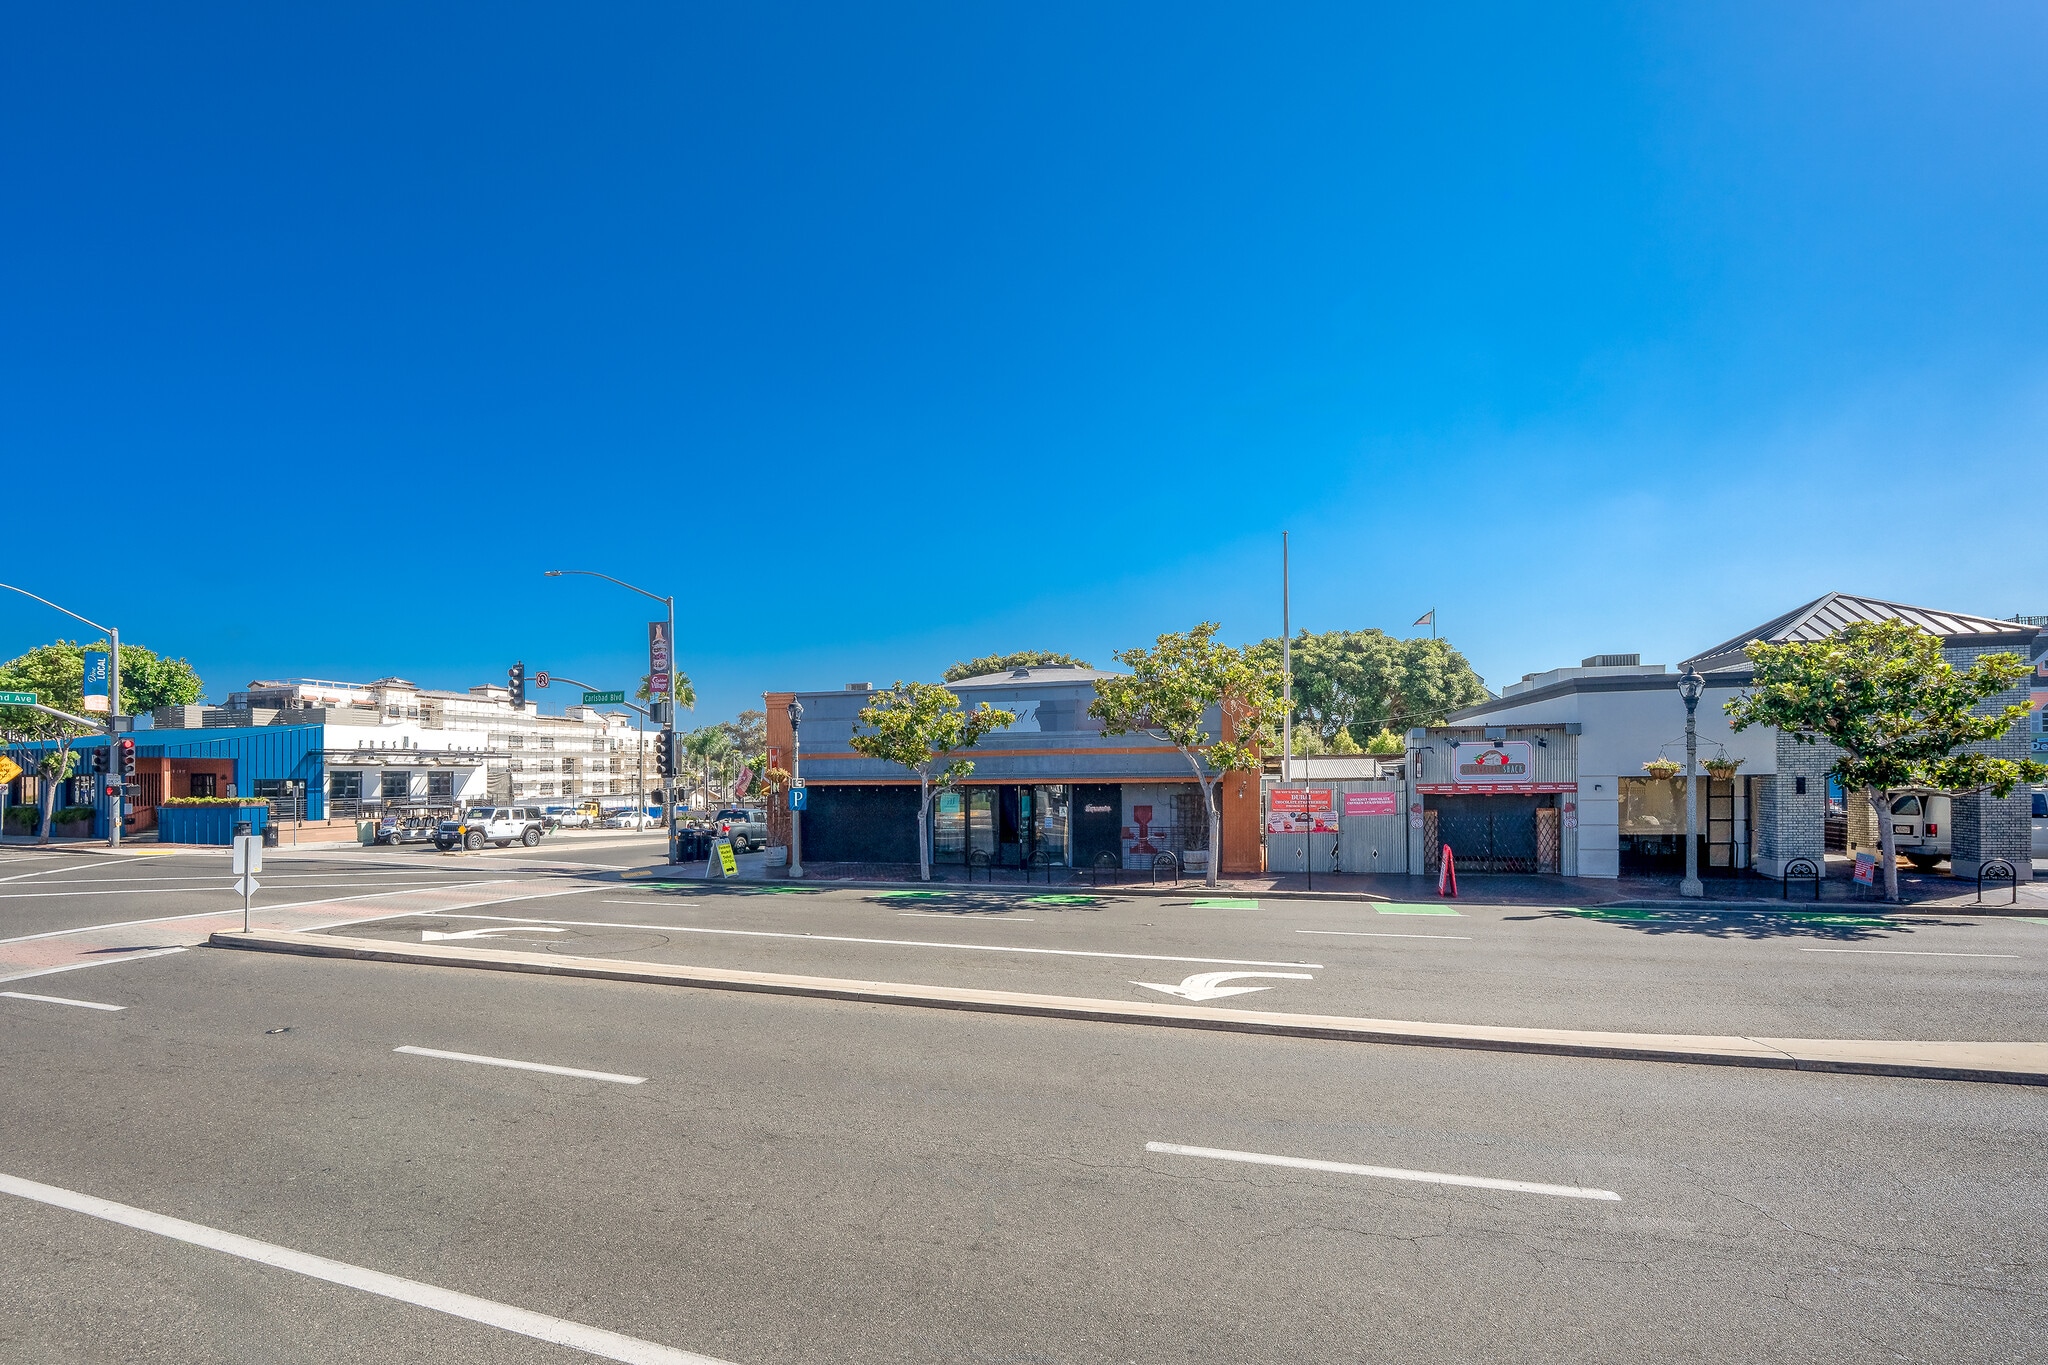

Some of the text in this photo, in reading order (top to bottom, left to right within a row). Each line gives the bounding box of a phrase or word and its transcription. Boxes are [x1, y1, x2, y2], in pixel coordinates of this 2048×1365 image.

[96, 658, 106, 680] LOCAL
[14, 695, 32, 703] Ave
[584, 692, 622, 703] Carlsbad Blvd
[1503, 764, 1523, 774] SHACK
[793, 791, 804, 808] P
